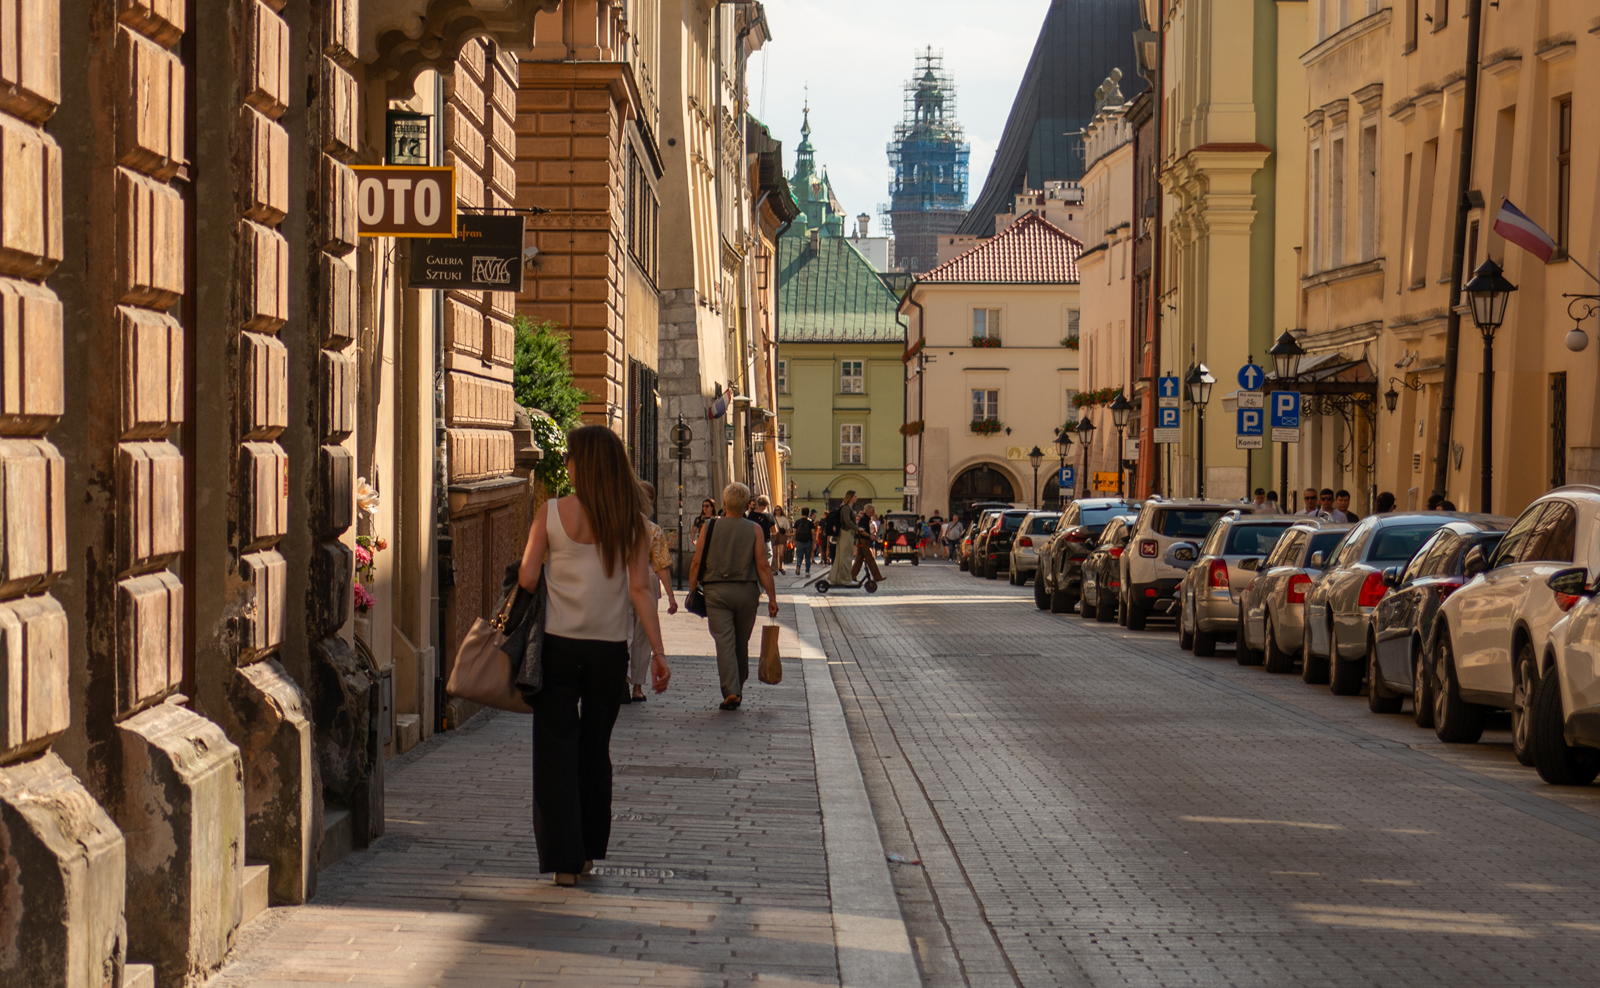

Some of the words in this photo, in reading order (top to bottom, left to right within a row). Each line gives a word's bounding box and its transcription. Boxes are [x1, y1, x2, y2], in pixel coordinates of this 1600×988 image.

[398, 134, 420, 156] 17
[358, 177, 441, 227] OTO
[426, 254, 464, 266] GALERIA
[425, 268, 462, 281] SZTUKI
[1277, 394, 1295, 417] P
[1163, 409, 1176, 426] P
[1243, 411, 1259, 432] P
[1238, 438, 1261, 446] Koniec
[1062, 469, 1071, 481] P
